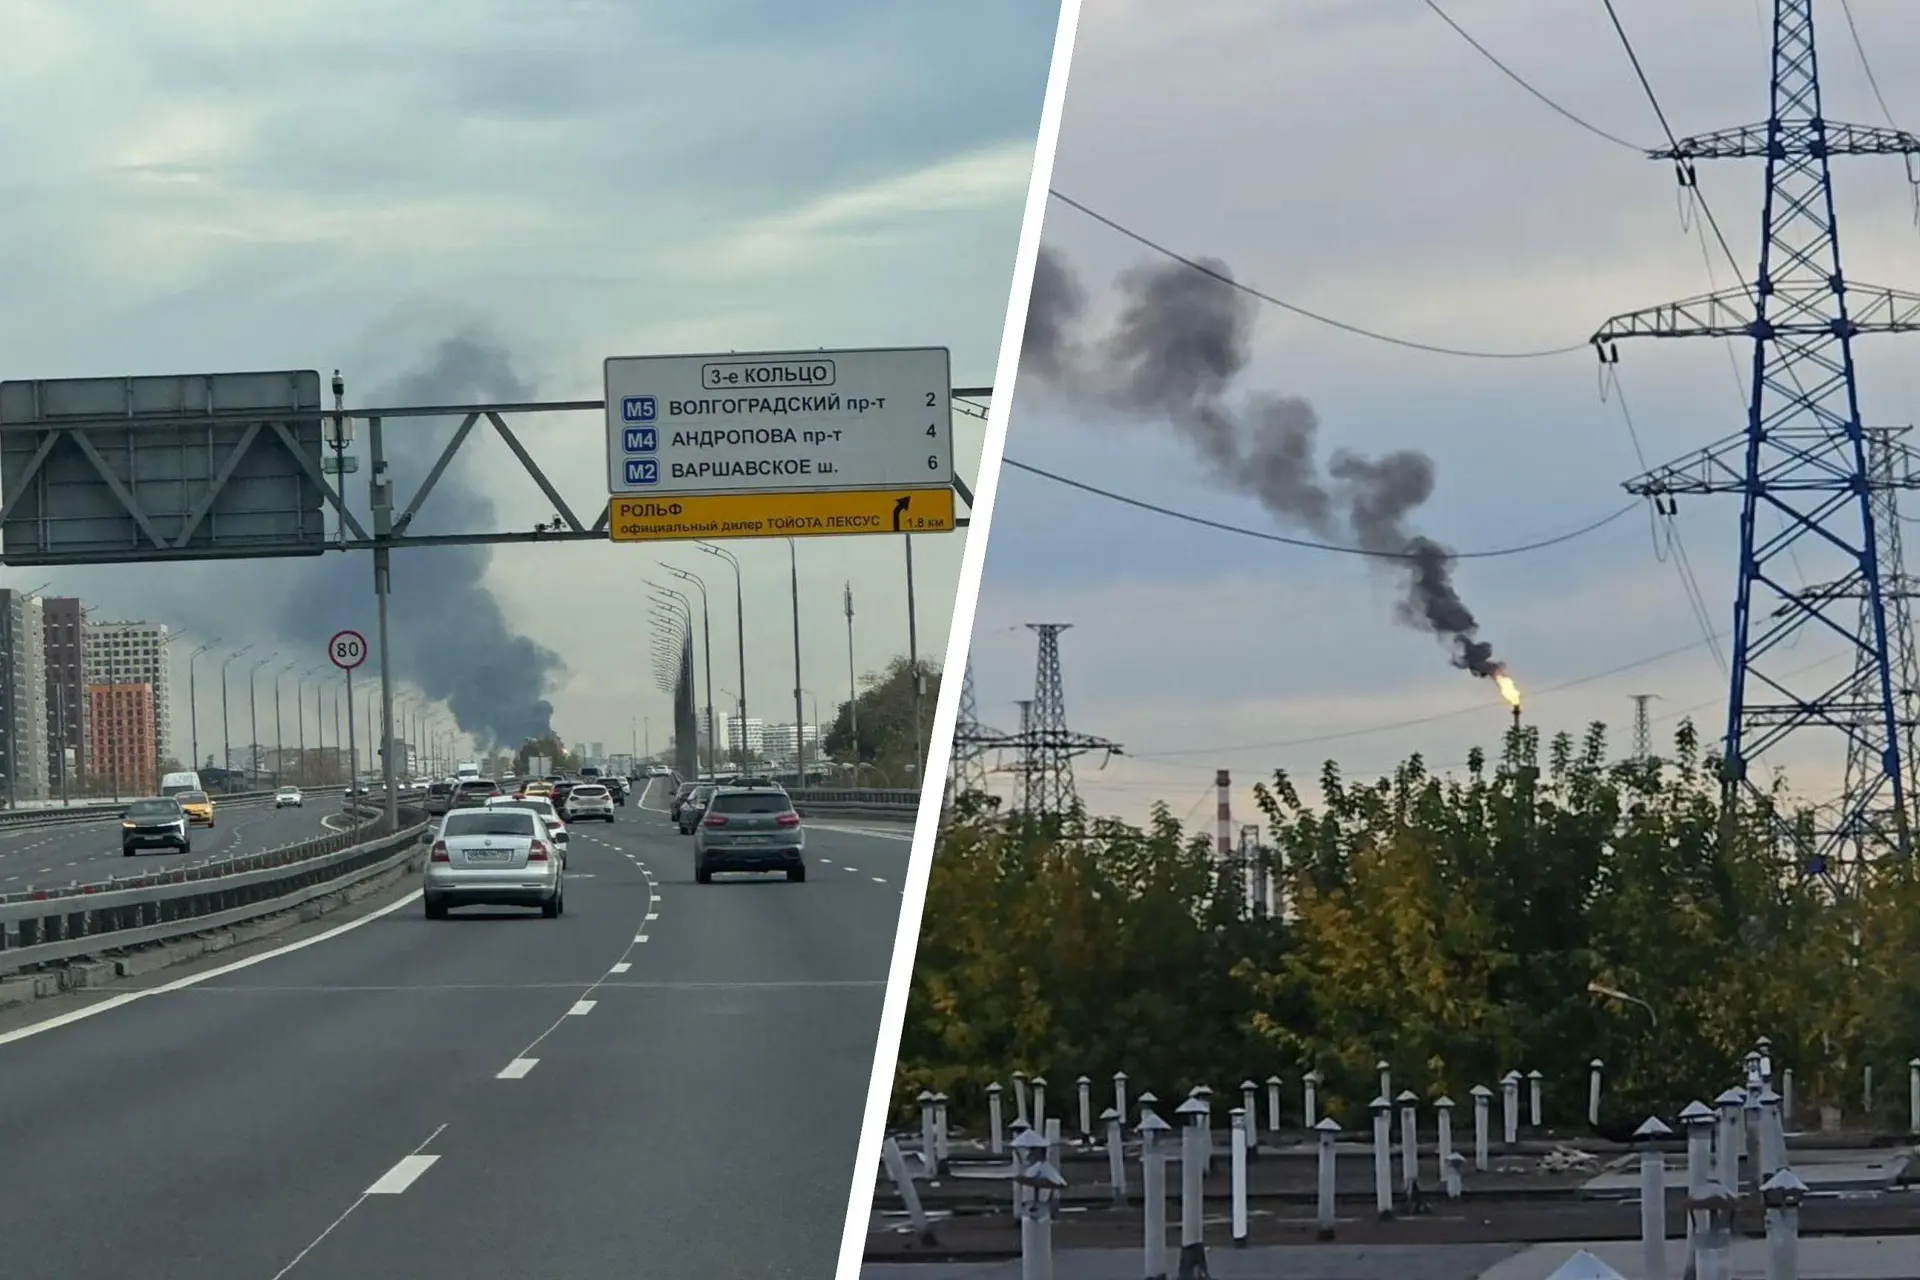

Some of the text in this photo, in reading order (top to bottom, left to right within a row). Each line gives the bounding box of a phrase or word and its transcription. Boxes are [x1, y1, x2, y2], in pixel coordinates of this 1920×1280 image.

[711, 365, 828, 386] 3-е КОЛЬЦО
[669, 393, 841, 416] ВОЛГОГРАДСКИЙ
[847, 397, 886, 413] пр-т
[925, 392, 937, 407] 2
[671, 428, 797, 449] АНДРОПОВА
[803, 430, 843, 445] пр-т
[926, 424, 937, 438] 4
[671, 459, 812, 478] ВАРШАВСКОЕ
[818, 462, 838, 474] ш.
[928, 455, 938, 470] 6
[620, 503, 683, 517] РОЛЬФ
[620, 515, 881, 535] официальный дилер ТОЙОТА ЛЕКСУС
[927, 518, 945, 528] км
[337, 641, 359, 658] 80
